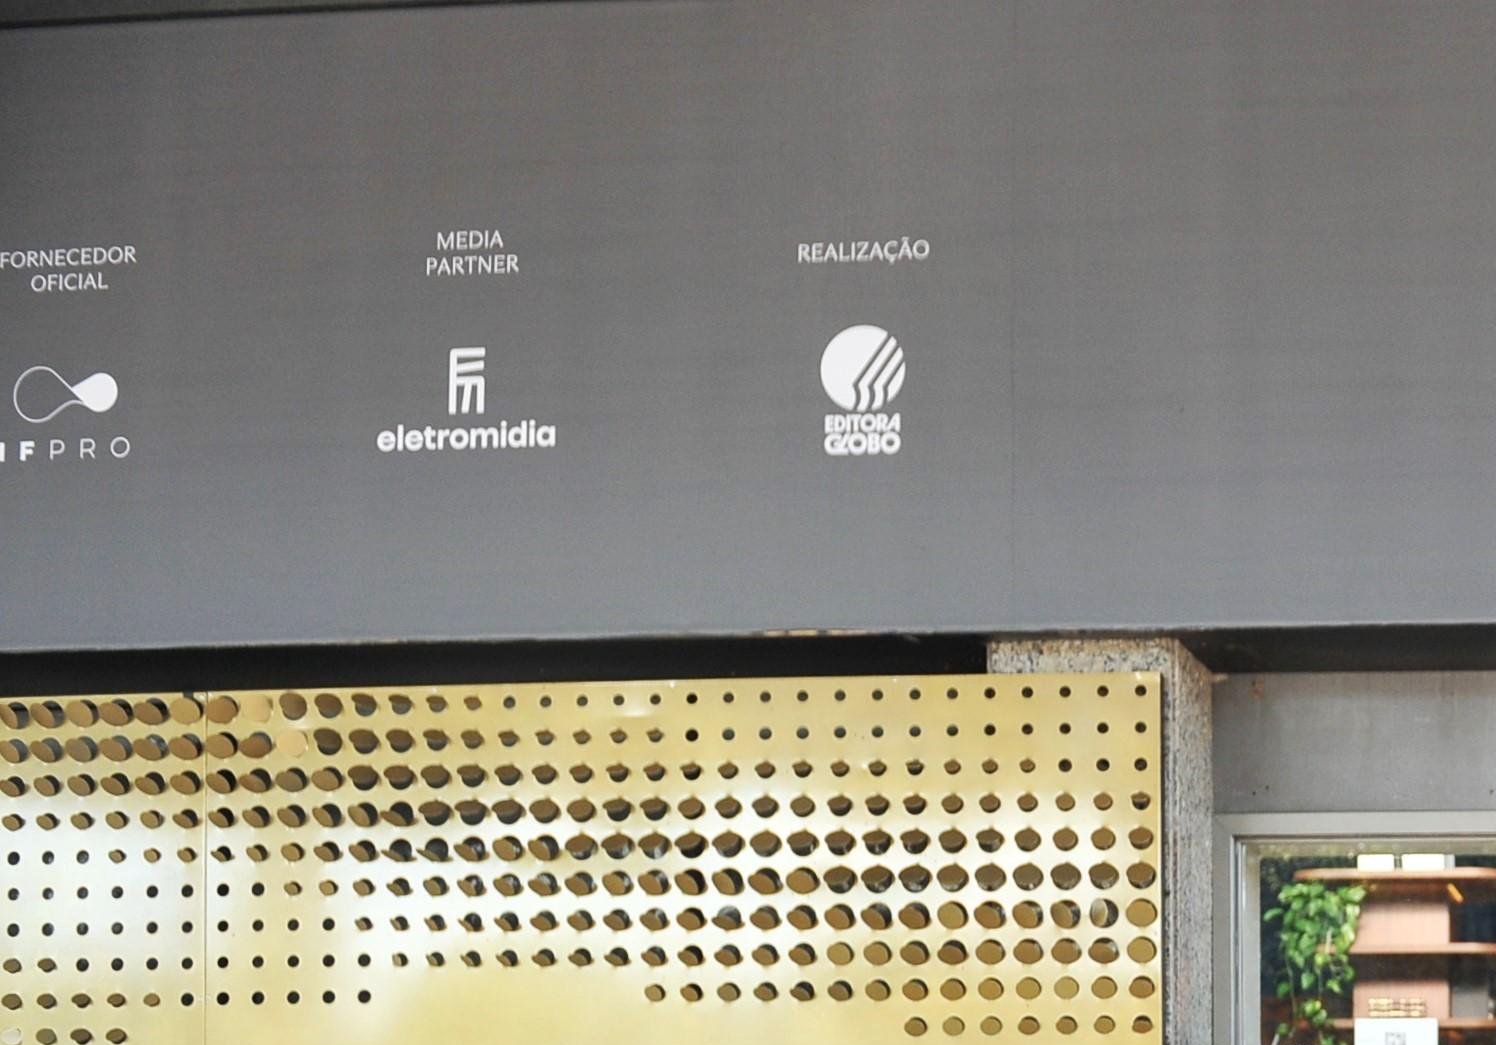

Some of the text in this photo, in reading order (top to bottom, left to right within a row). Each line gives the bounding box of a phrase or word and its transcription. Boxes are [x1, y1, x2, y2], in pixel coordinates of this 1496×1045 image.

[435, 229, 504, 251] MEDIA
[797, 236, 930, 265] REALIZAÇÃO
[0, 245, 137, 268] FORNECEDOR
[425, 254, 520, 277] PARTNER
[30, 271, 109, 293] OFICIAL
[824, 413, 901, 433] EDITORA
[376, 418, 557, 453] eletromidia
[823, 432, 902, 455] GLOBO
